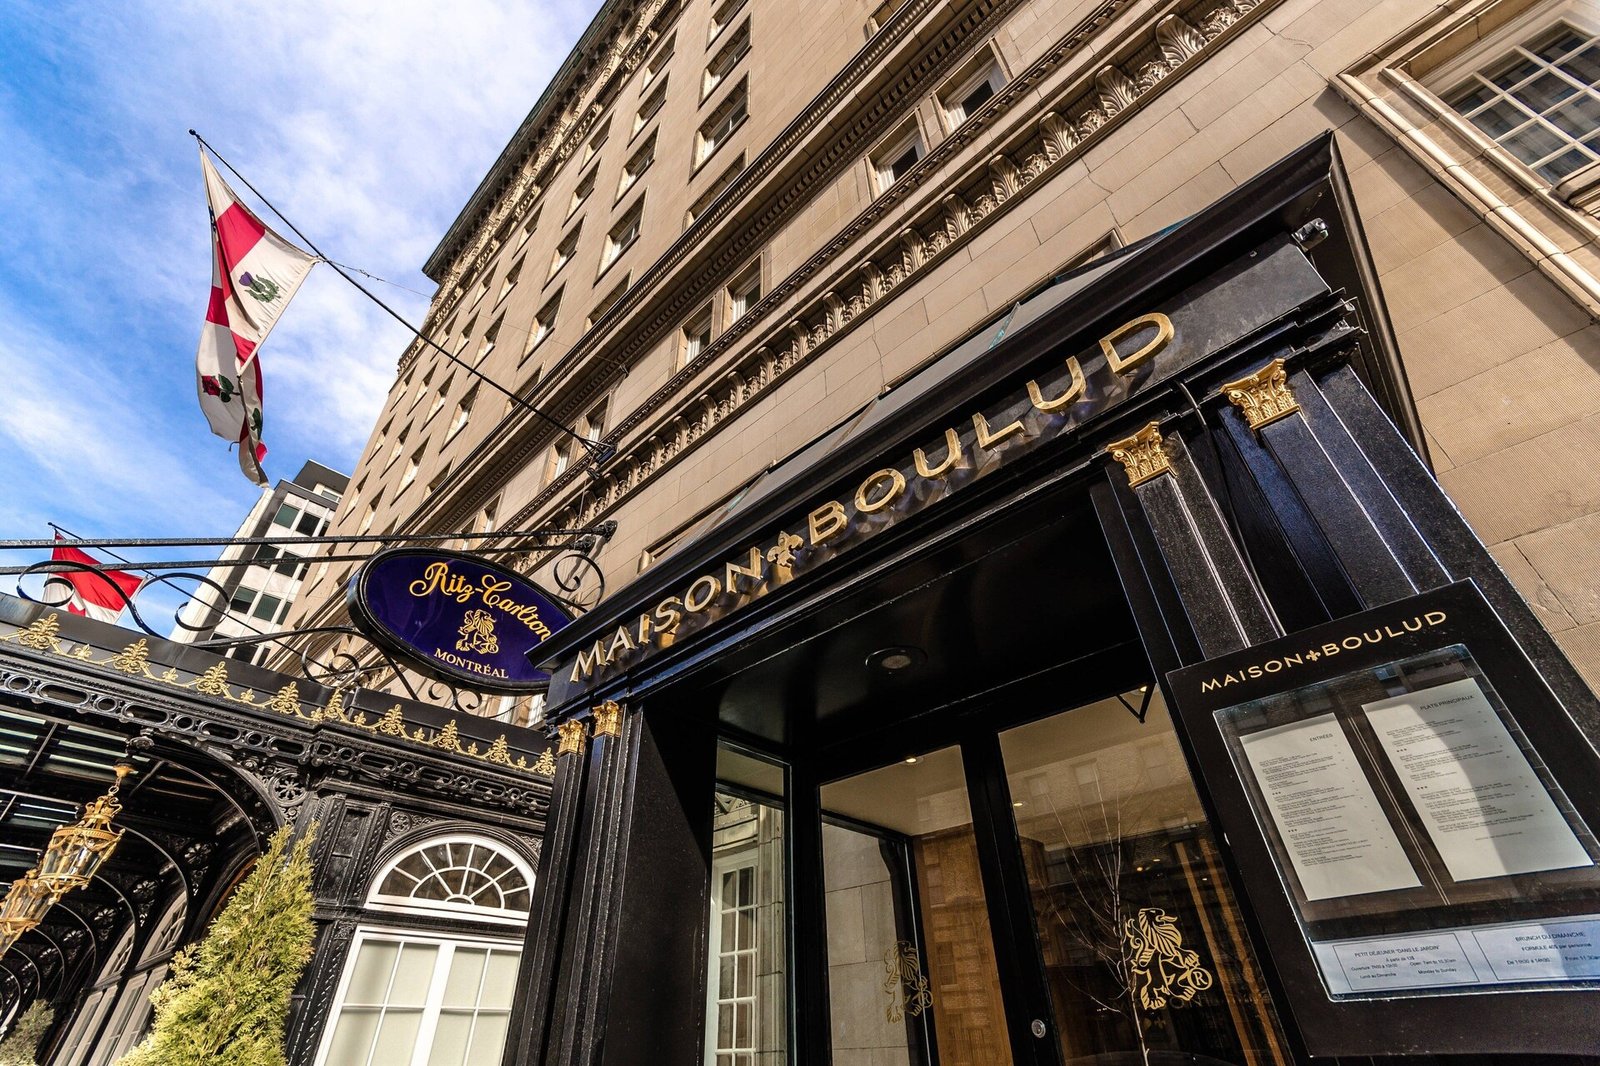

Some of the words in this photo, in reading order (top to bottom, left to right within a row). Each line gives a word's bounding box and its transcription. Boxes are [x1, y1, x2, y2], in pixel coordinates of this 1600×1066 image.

[569, 545, 766, 684] MAISON
[807, 311, 1175, 547] BOULUD
[409, 561, 552, 643] Ritz-Carlton
[433, 647, 509, 679] MONTRÉAL
[1201, 653, 1304, 693] MAISON
[1321, 611, 1447, 657] BOULUD
